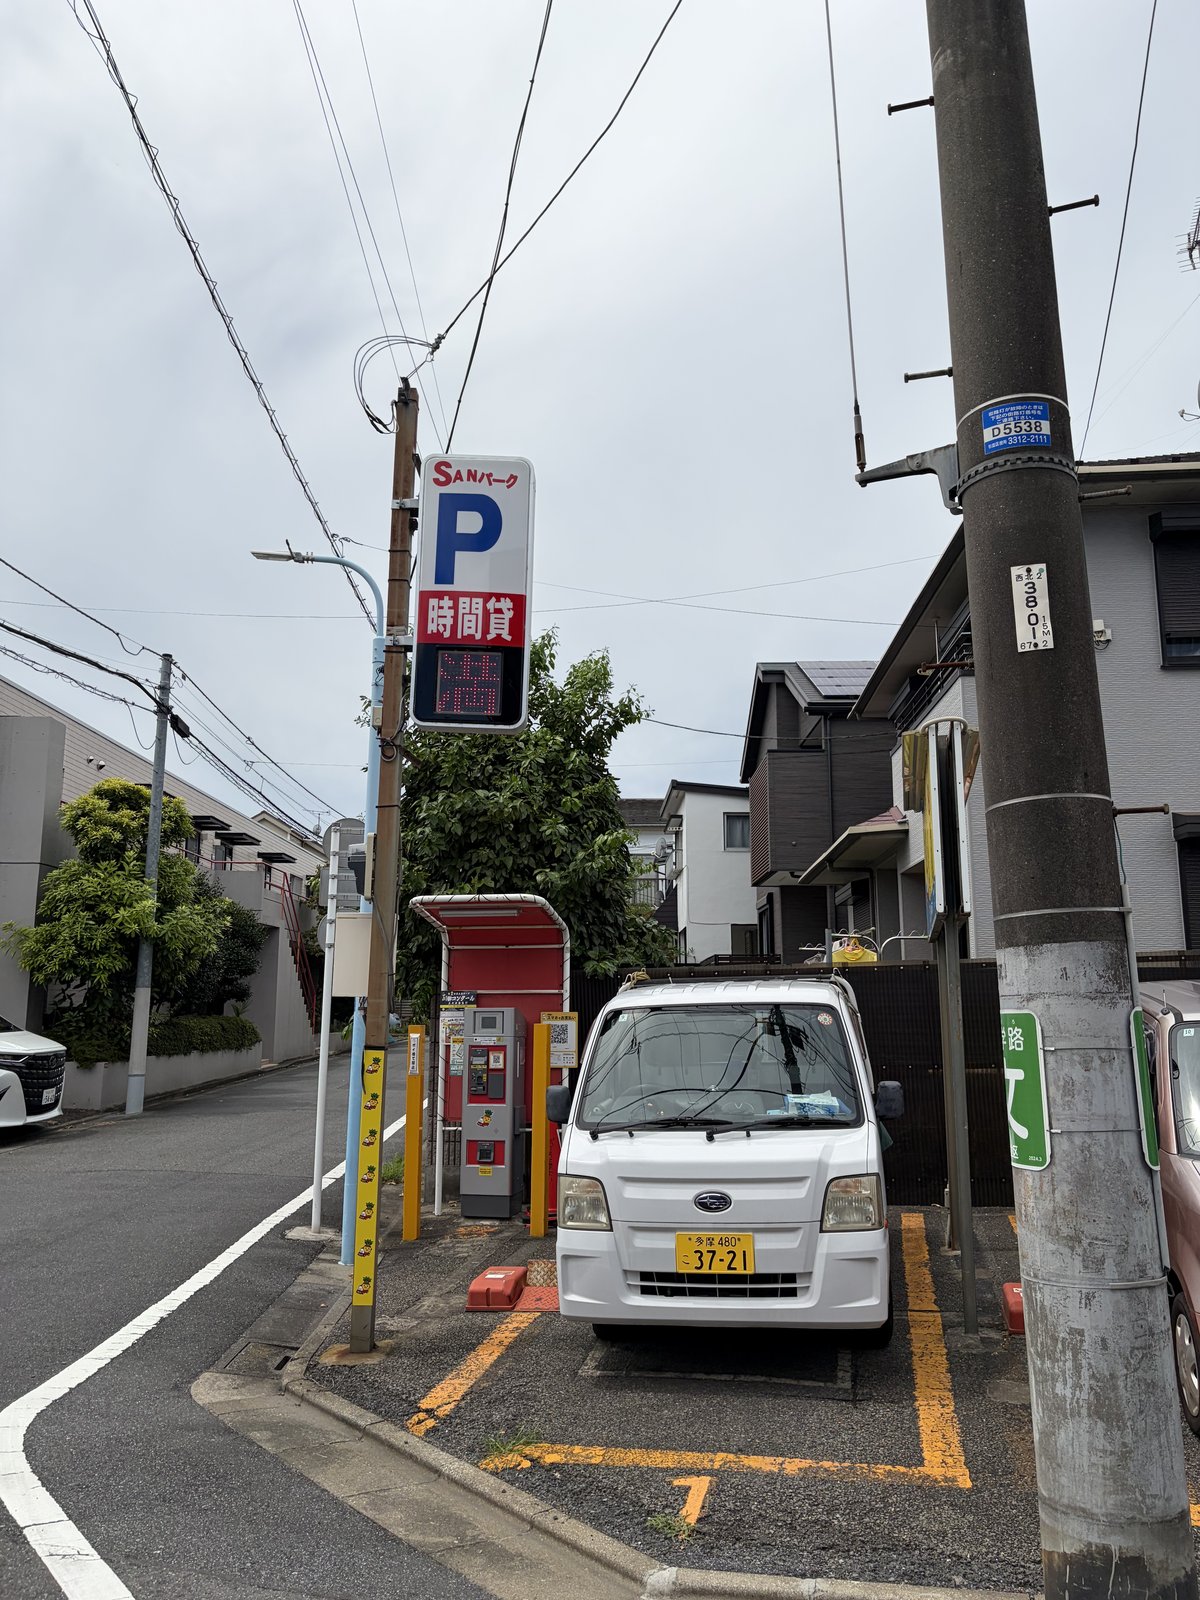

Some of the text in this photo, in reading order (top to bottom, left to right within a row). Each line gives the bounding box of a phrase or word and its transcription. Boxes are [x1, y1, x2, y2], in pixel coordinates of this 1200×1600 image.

[991, 421, 1043, 438] D5538
[1008, 434, 1047, 445] 3312-2111
[432, 460, 518, 490] SANパーク
[434, 493, 503, 585] P
[427, 595, 514, 642] 時間貸
[437, 653, 499, 714] 満
[695, 1236, 737, 1247] 多摩 480
[693, 1249, 747, 1271] 37-21
